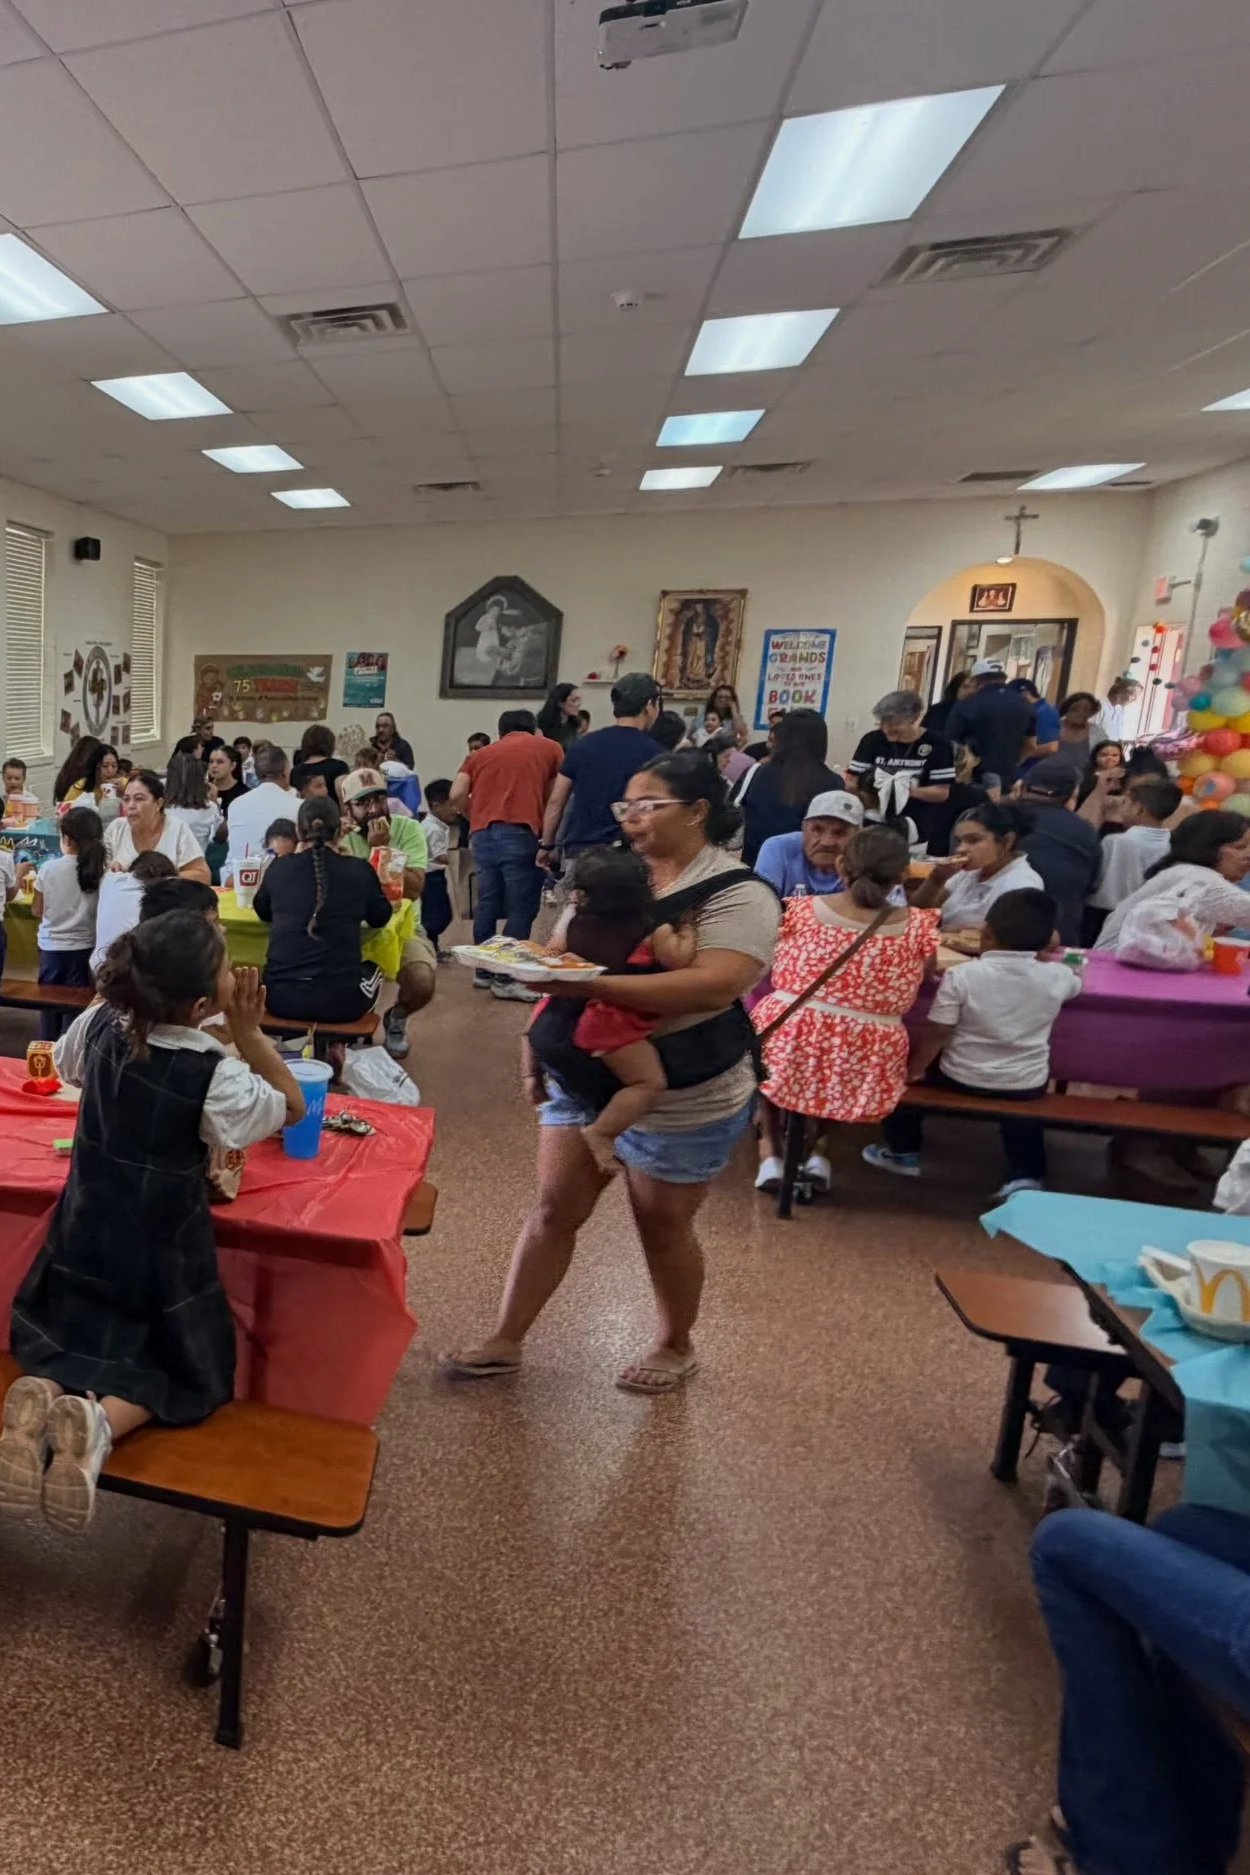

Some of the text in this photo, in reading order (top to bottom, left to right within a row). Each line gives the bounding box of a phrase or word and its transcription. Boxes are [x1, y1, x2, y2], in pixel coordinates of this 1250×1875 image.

[769, 651, 827, 664] GRANDS
[234, 679, 251, 693] 75
[768, 689, 817, 705] BOOK
[887, 758, 927, 767] ANTHONY
[241, 871, 257, 883] QT
